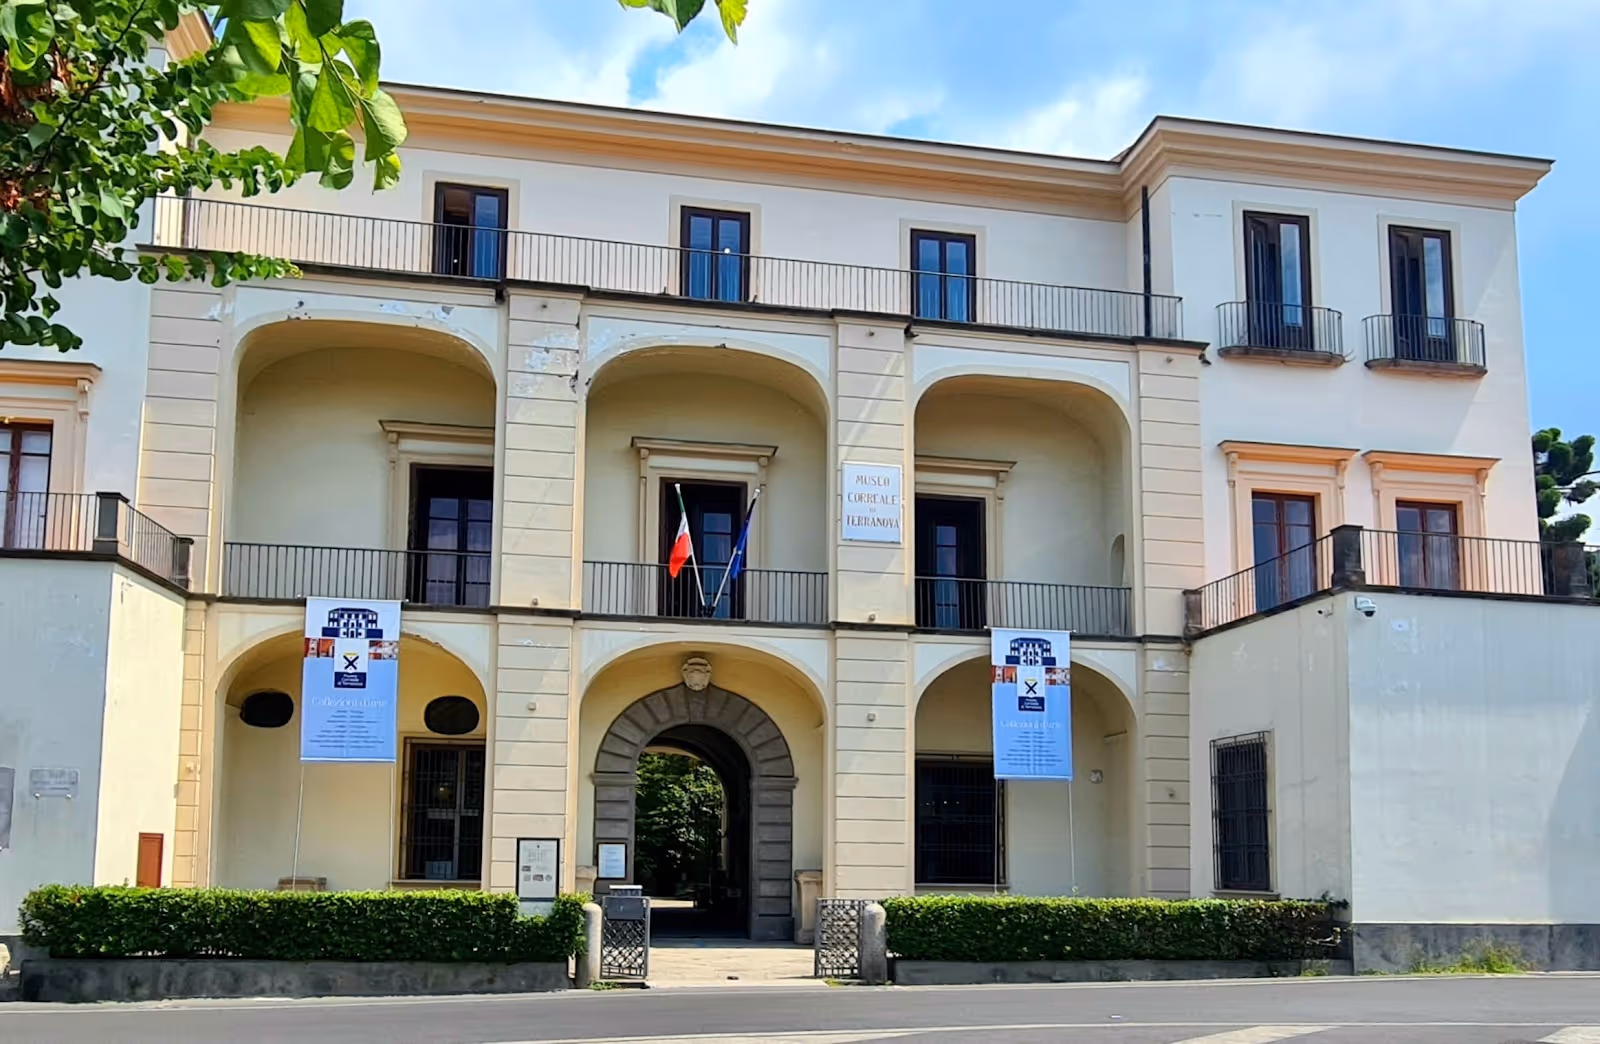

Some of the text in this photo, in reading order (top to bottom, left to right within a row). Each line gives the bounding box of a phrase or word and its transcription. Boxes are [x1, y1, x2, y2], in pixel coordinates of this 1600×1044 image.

[855, 474, 890, 487] MUSEO
[847, 491, 898, 505] CORREALE
[846, 514, 899, 528] TERRANOVA
